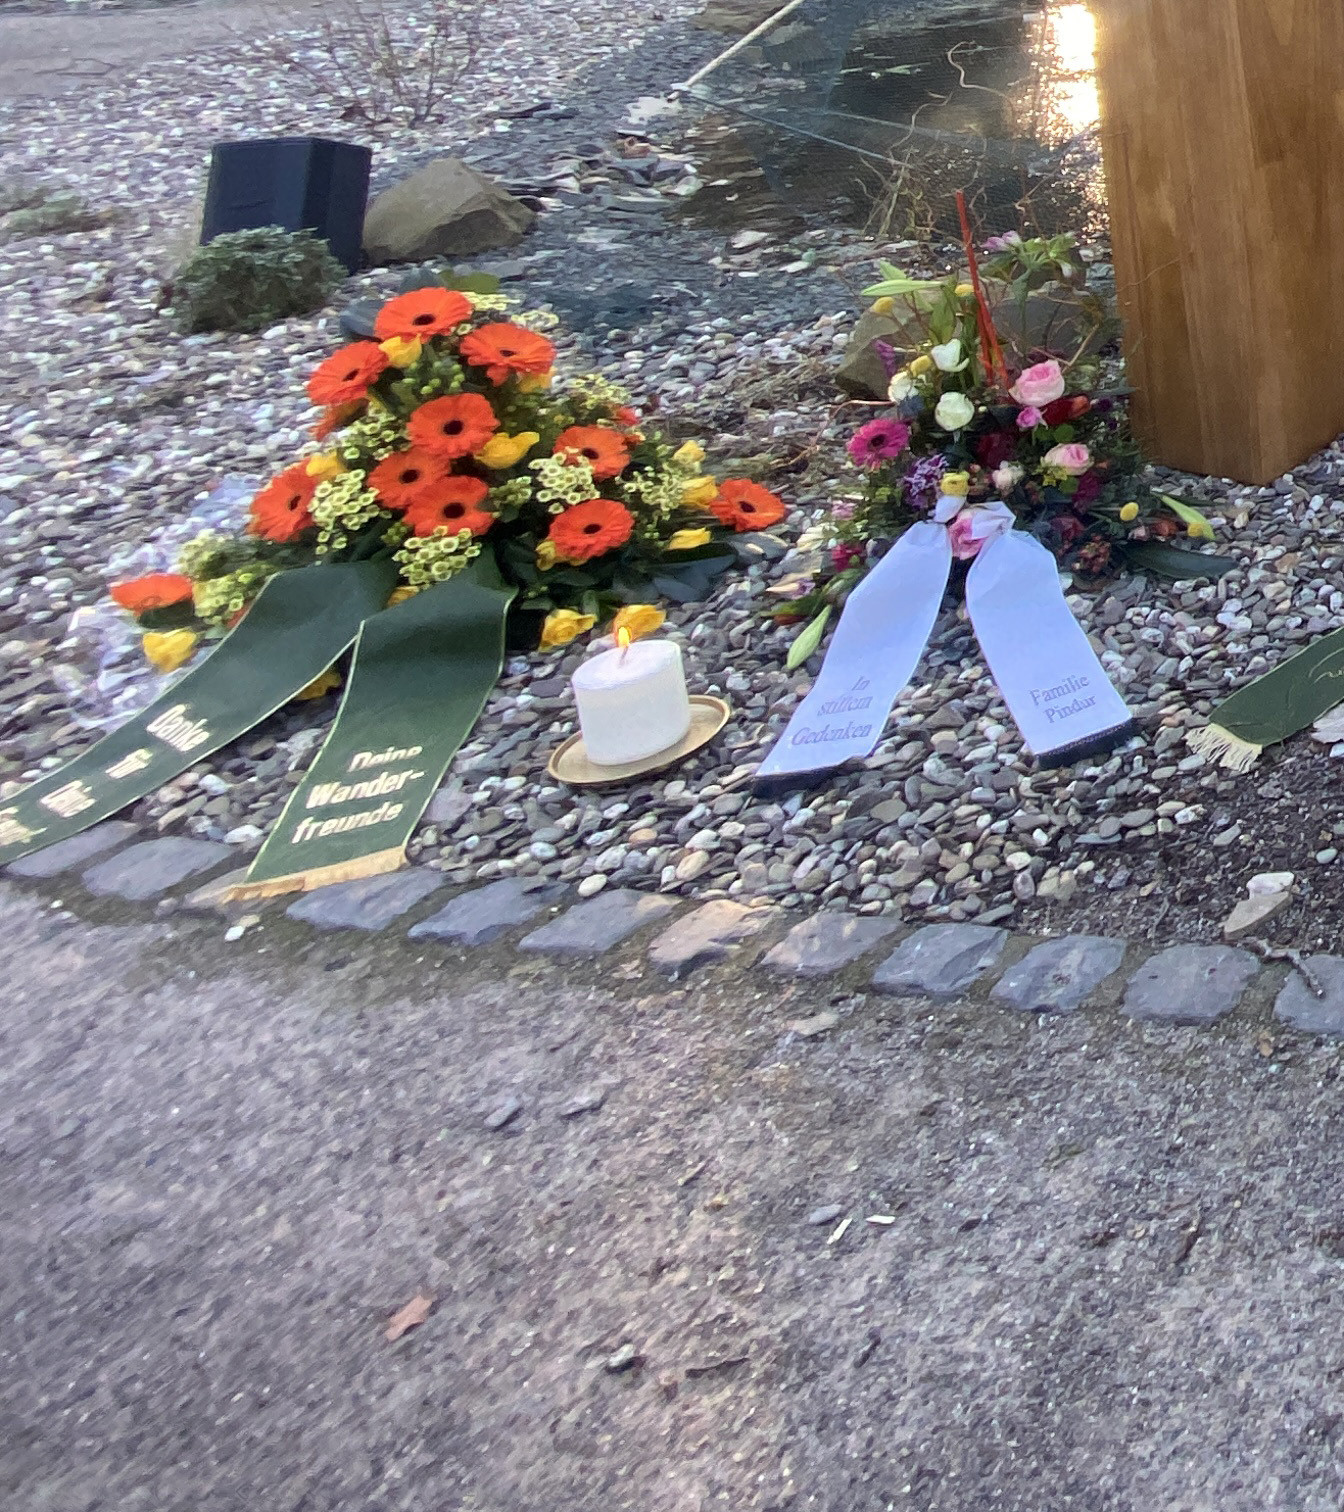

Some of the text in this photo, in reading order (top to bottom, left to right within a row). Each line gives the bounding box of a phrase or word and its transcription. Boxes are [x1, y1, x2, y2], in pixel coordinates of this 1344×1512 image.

[851, 675, 871, 691] In
[1029, 674, 1090, 706] Familie
[817, 694, 873, 717] stillem
[1043, 695, 1097, 724] Pindur
[146, 703, 210, 752] Danke
[791, 720, 873, 746] Gedenken
[346, 745, 423, 773] Deine
[305, 769, 425, 809] Wander-
[291, 801, 404, 844] freunde
